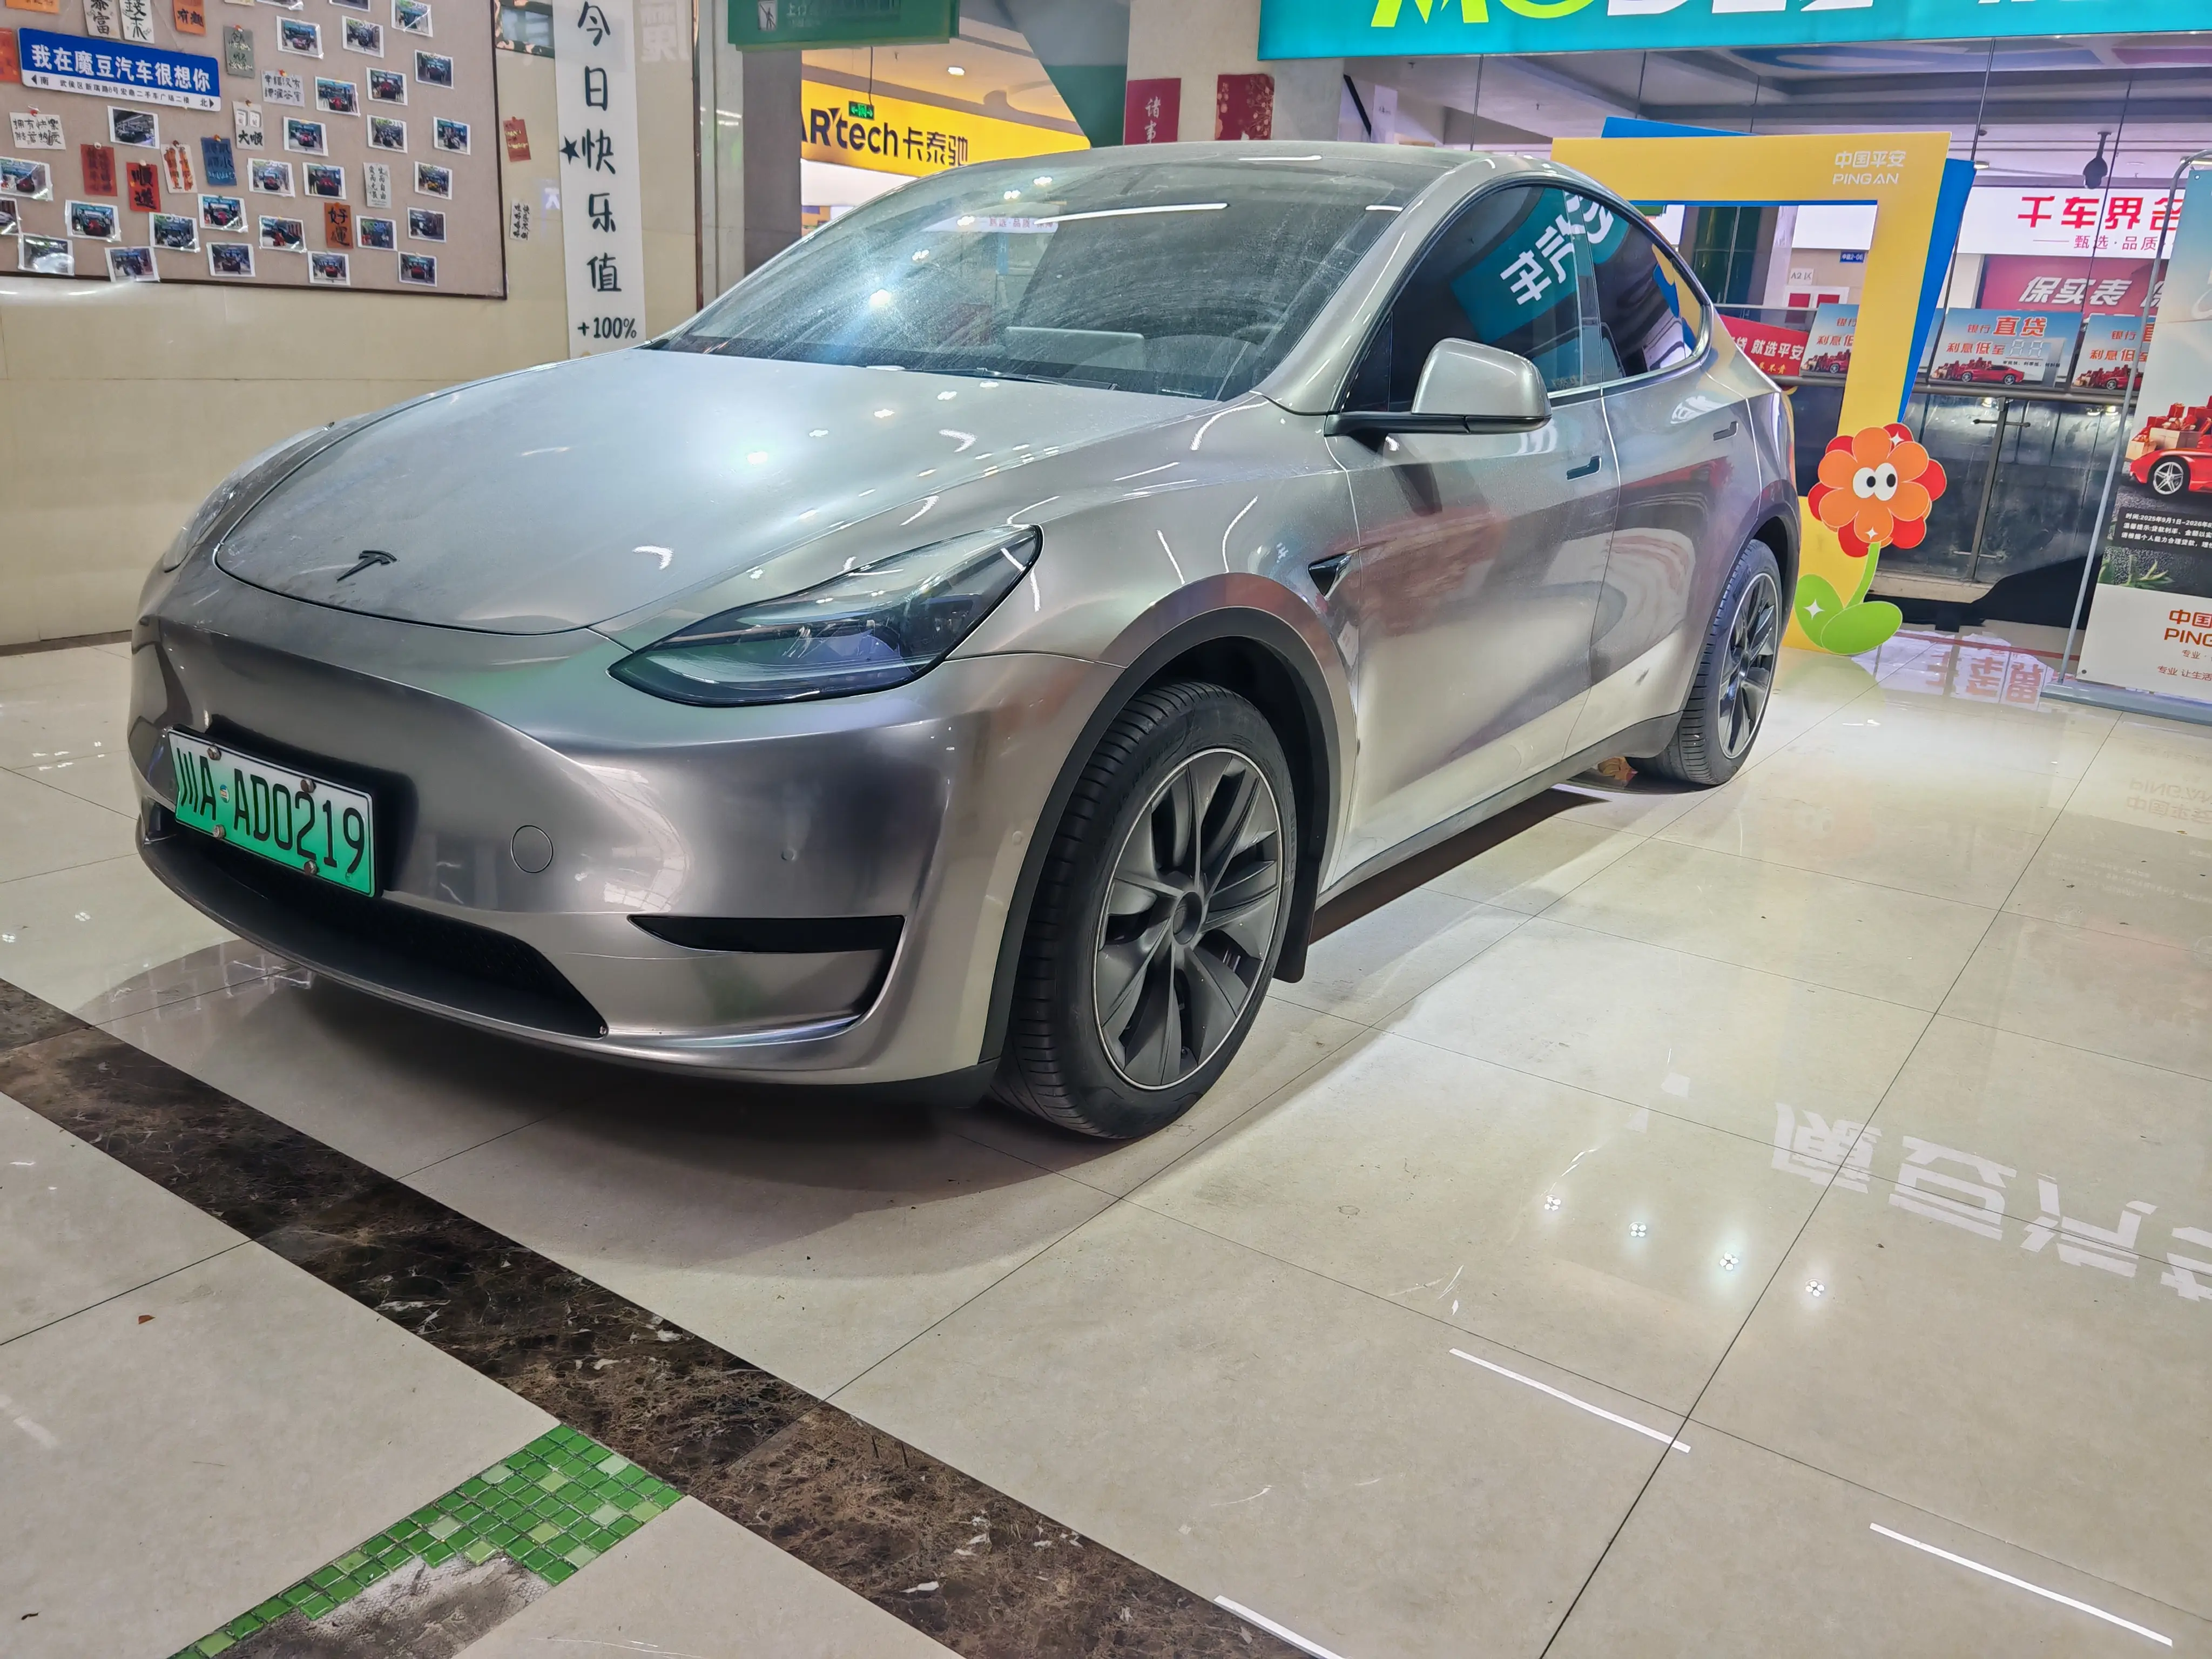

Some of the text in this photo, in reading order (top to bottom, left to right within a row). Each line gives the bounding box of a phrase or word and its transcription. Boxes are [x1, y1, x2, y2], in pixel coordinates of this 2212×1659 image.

[31, 44, 211, 92] 我在魔豆汽车很想你
[200, 98, 208, 107] 北
[577, 1, 622, 292] 今日快乐值
[902, 126, 969, 167] 卡泰驰
[1835, 151, 1906, 168] 中国平安
[2018, 276, 2133, 306] 保实表
[577, 317, 637, 339] +100%
[1751, 339, 1804, 361] 就选平安
[2157, 665, 2178, 676] 专业
